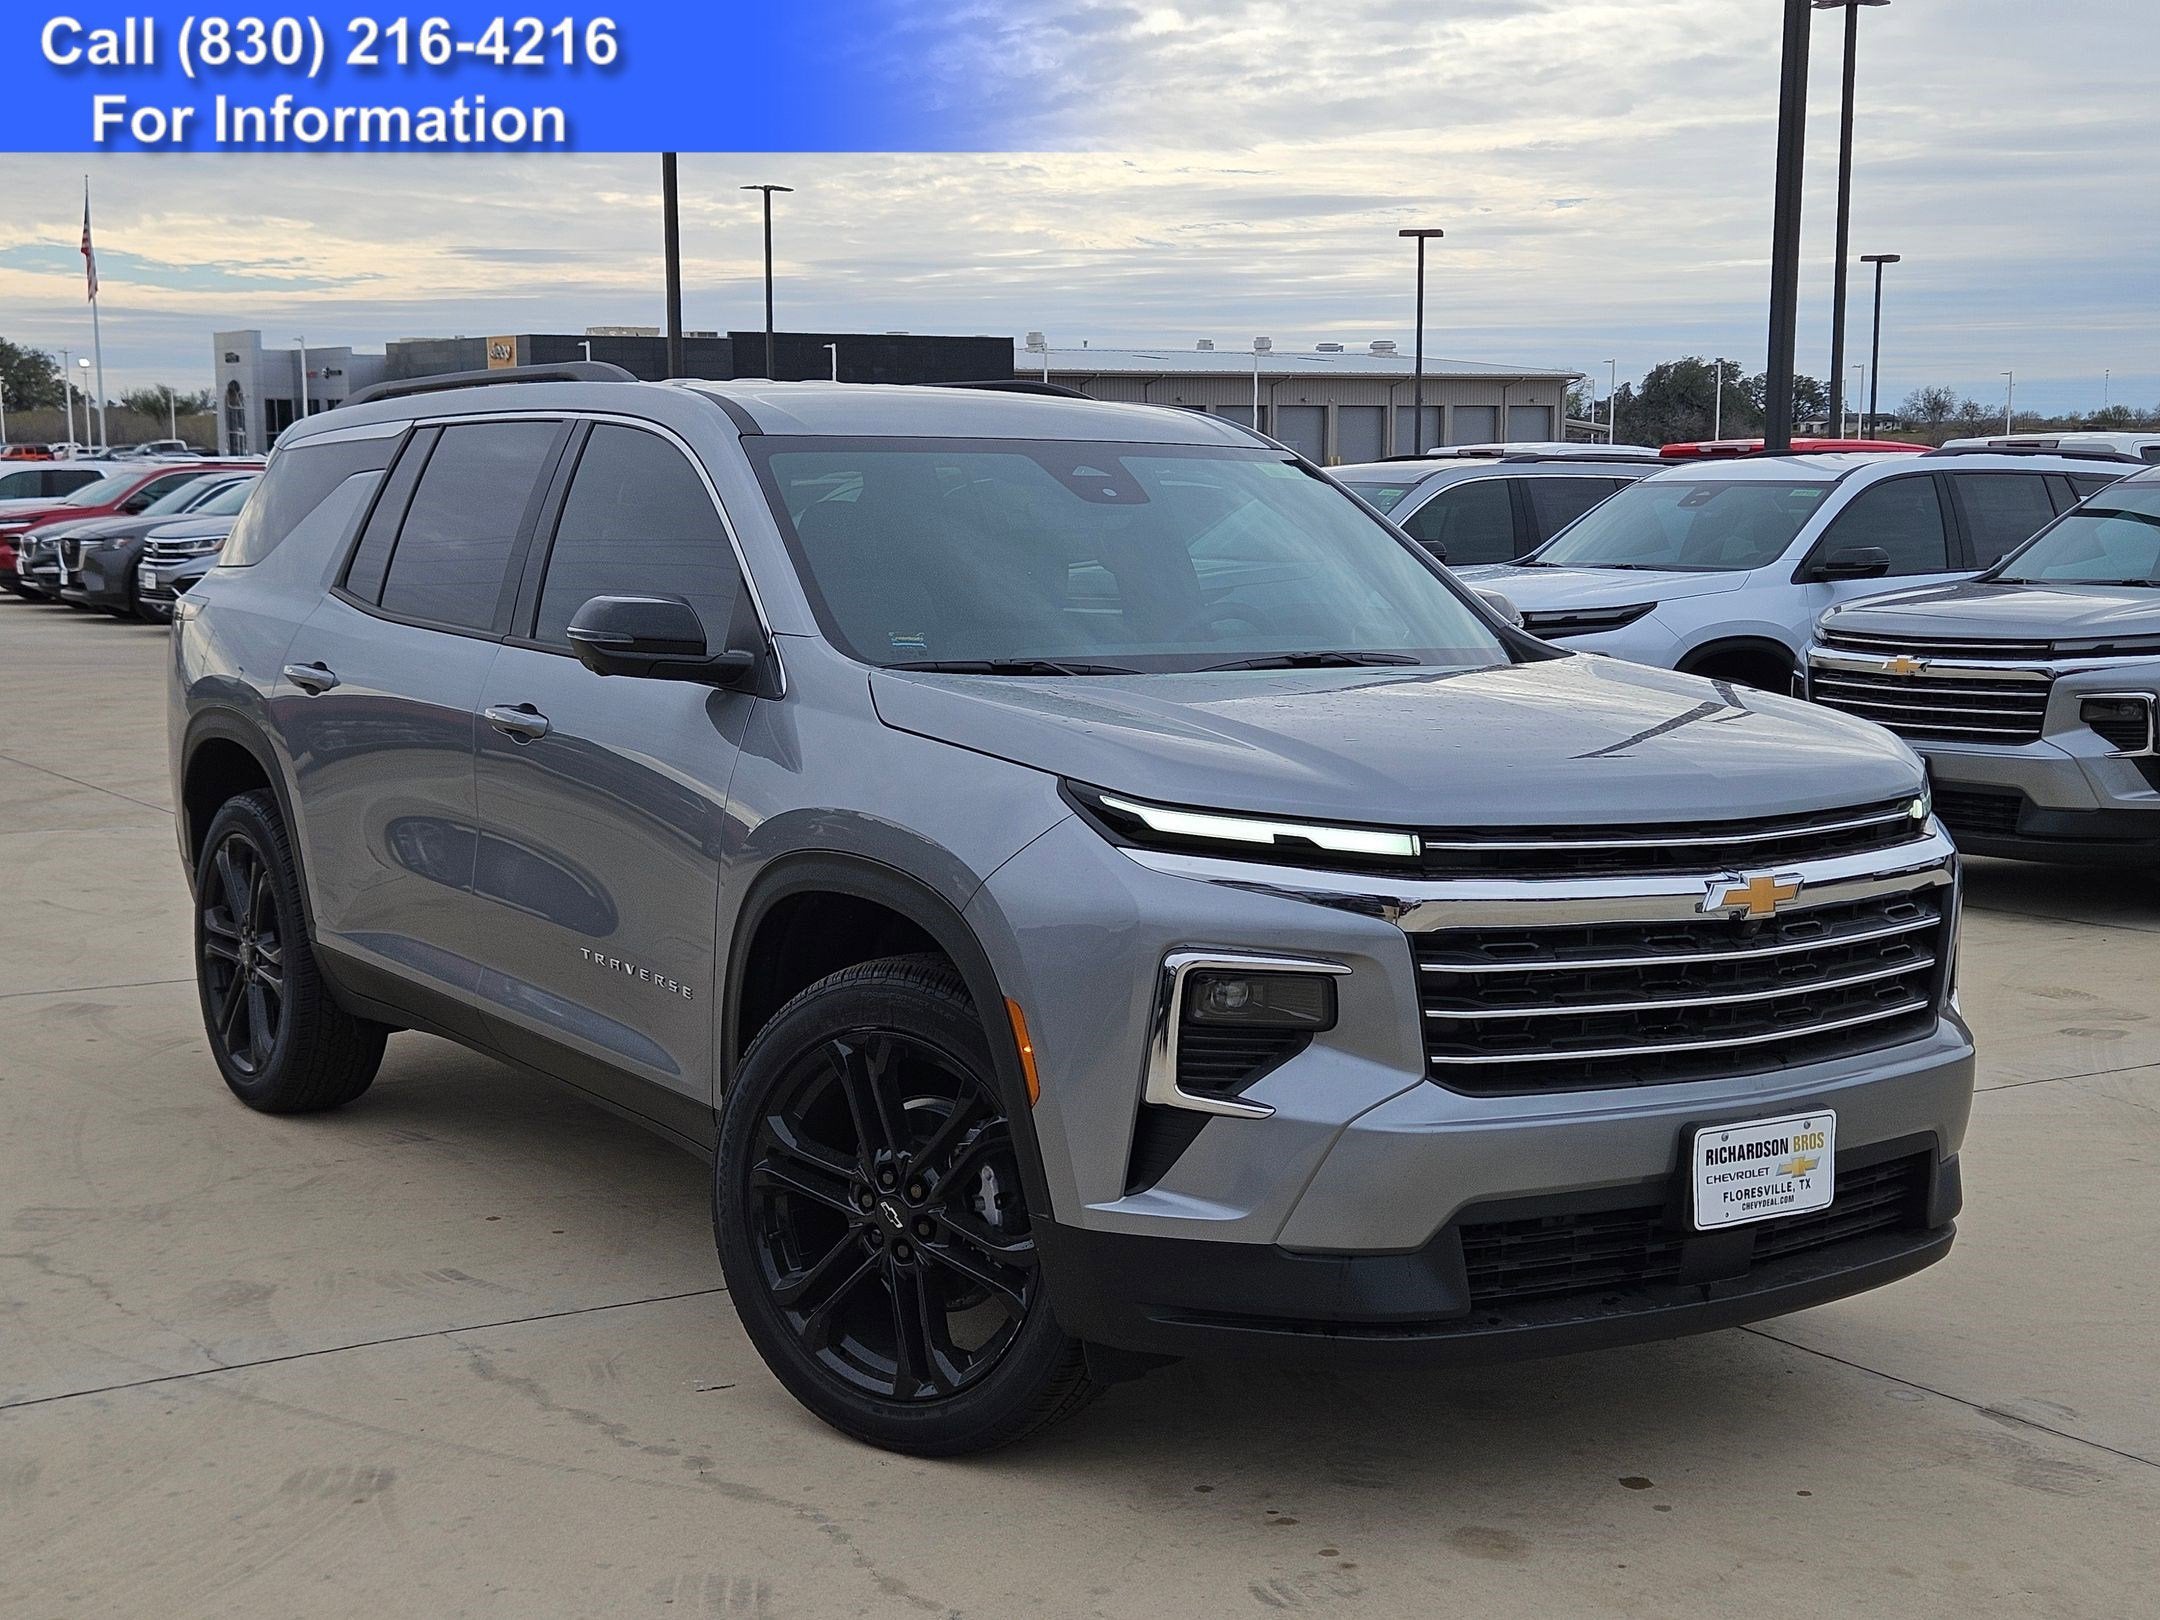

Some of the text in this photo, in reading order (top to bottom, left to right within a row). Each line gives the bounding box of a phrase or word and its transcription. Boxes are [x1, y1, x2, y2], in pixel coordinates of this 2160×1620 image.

[580, 947, 693, 999] TRAVERSE
[1705, 1131, 1824, 1166] RICHARDSON BROS
[1706, 1167, 1770, 1185] CHEVROLET
[1723, 1178, 1812, 1203] FLORESVILLE, TX
[1741, 1195, 1795, 1211] CHEVYDEAL.COM
